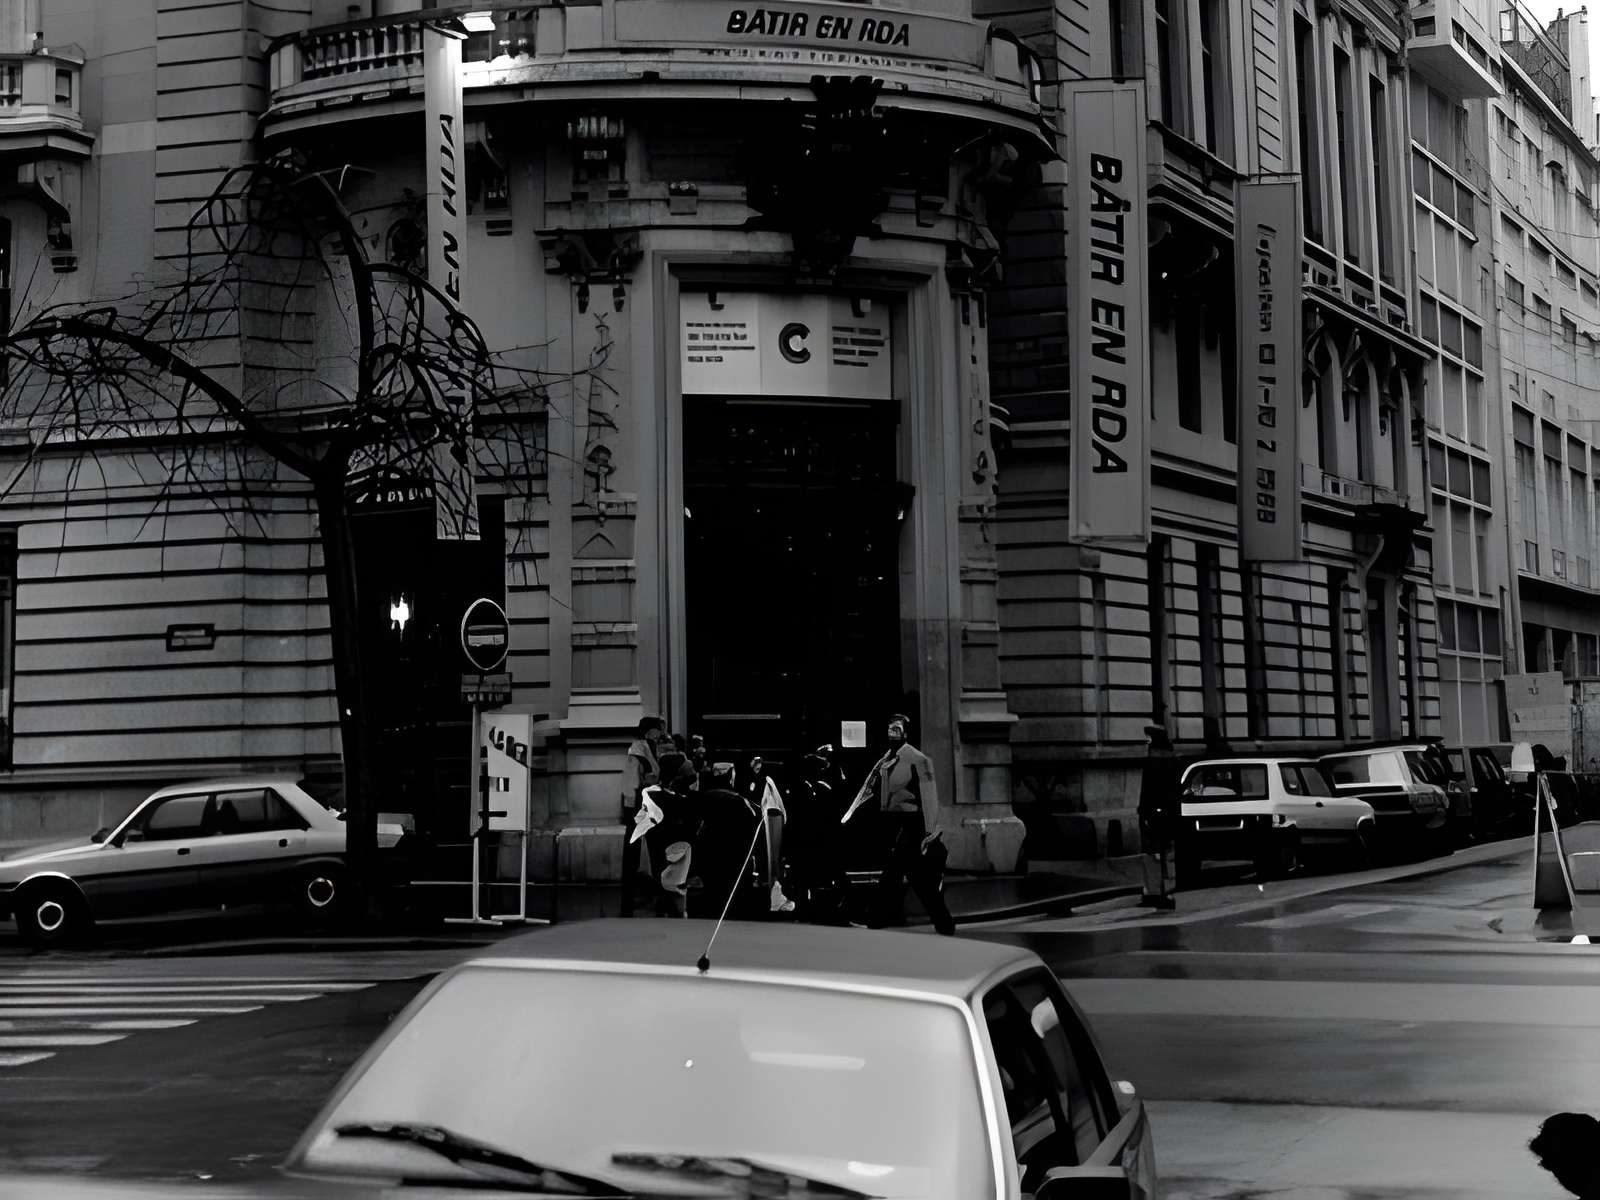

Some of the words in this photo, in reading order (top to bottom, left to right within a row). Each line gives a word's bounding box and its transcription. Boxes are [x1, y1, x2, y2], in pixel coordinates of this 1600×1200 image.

[815, 14, 853, 41] EN
[1090, 297, 1127, 365] EN
[1090, 374, 1129, 474] RDA
